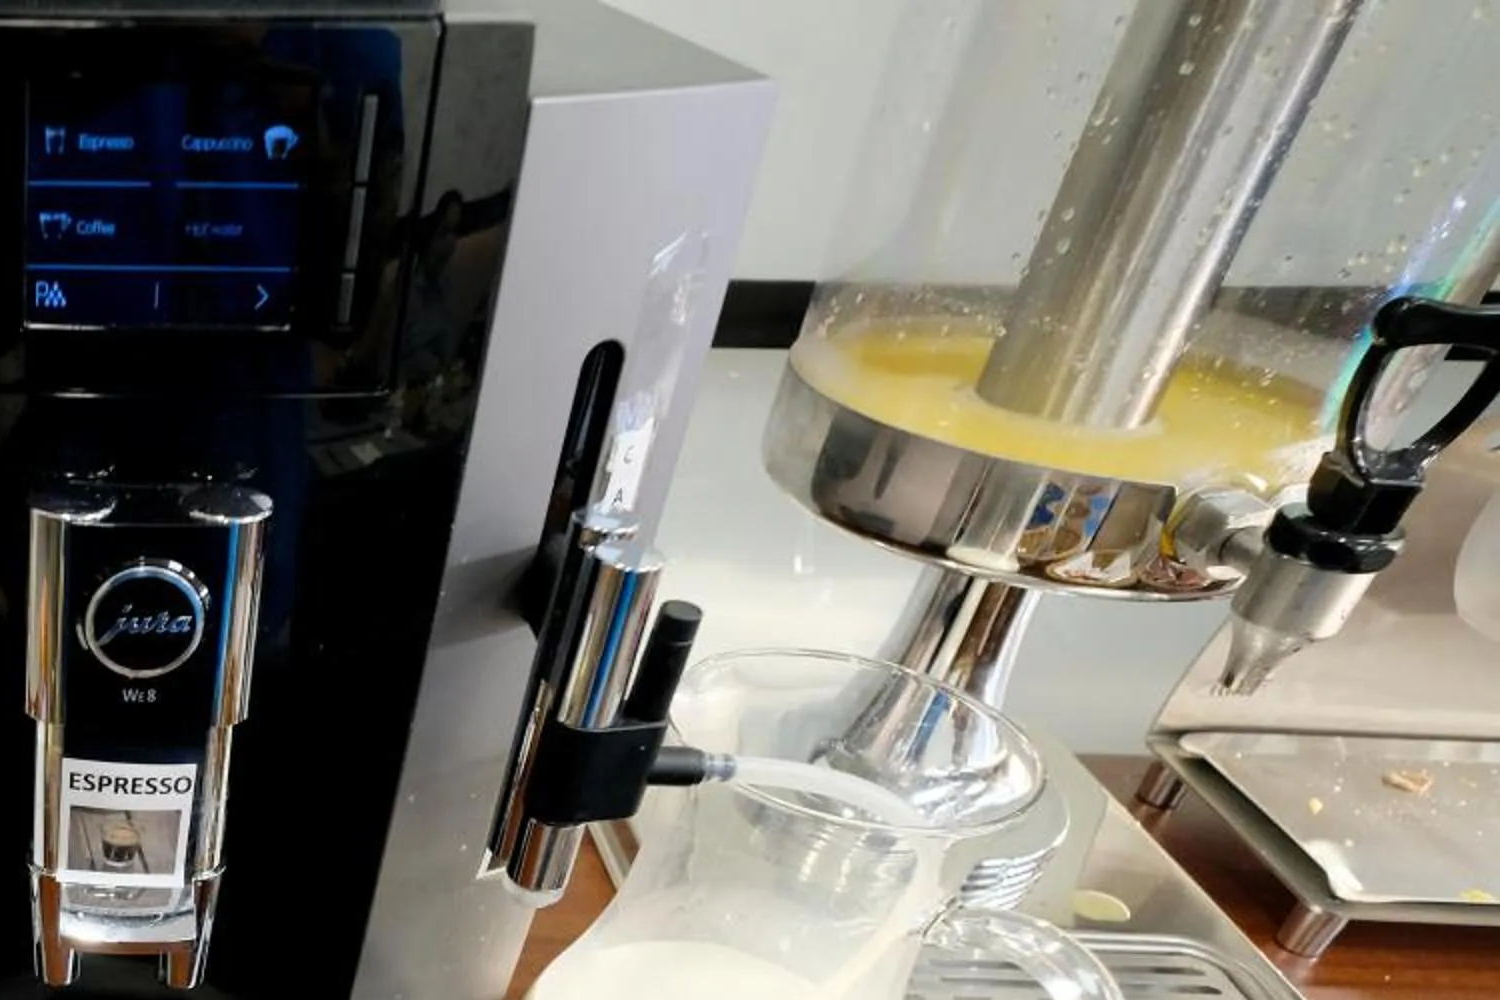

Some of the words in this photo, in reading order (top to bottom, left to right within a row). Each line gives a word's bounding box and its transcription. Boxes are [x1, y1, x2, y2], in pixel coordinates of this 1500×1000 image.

[75, 219, 117, 236] Coffee
[97, 603, 193, 647] jura
[68, 771, 193, 795] ESPRESSO
